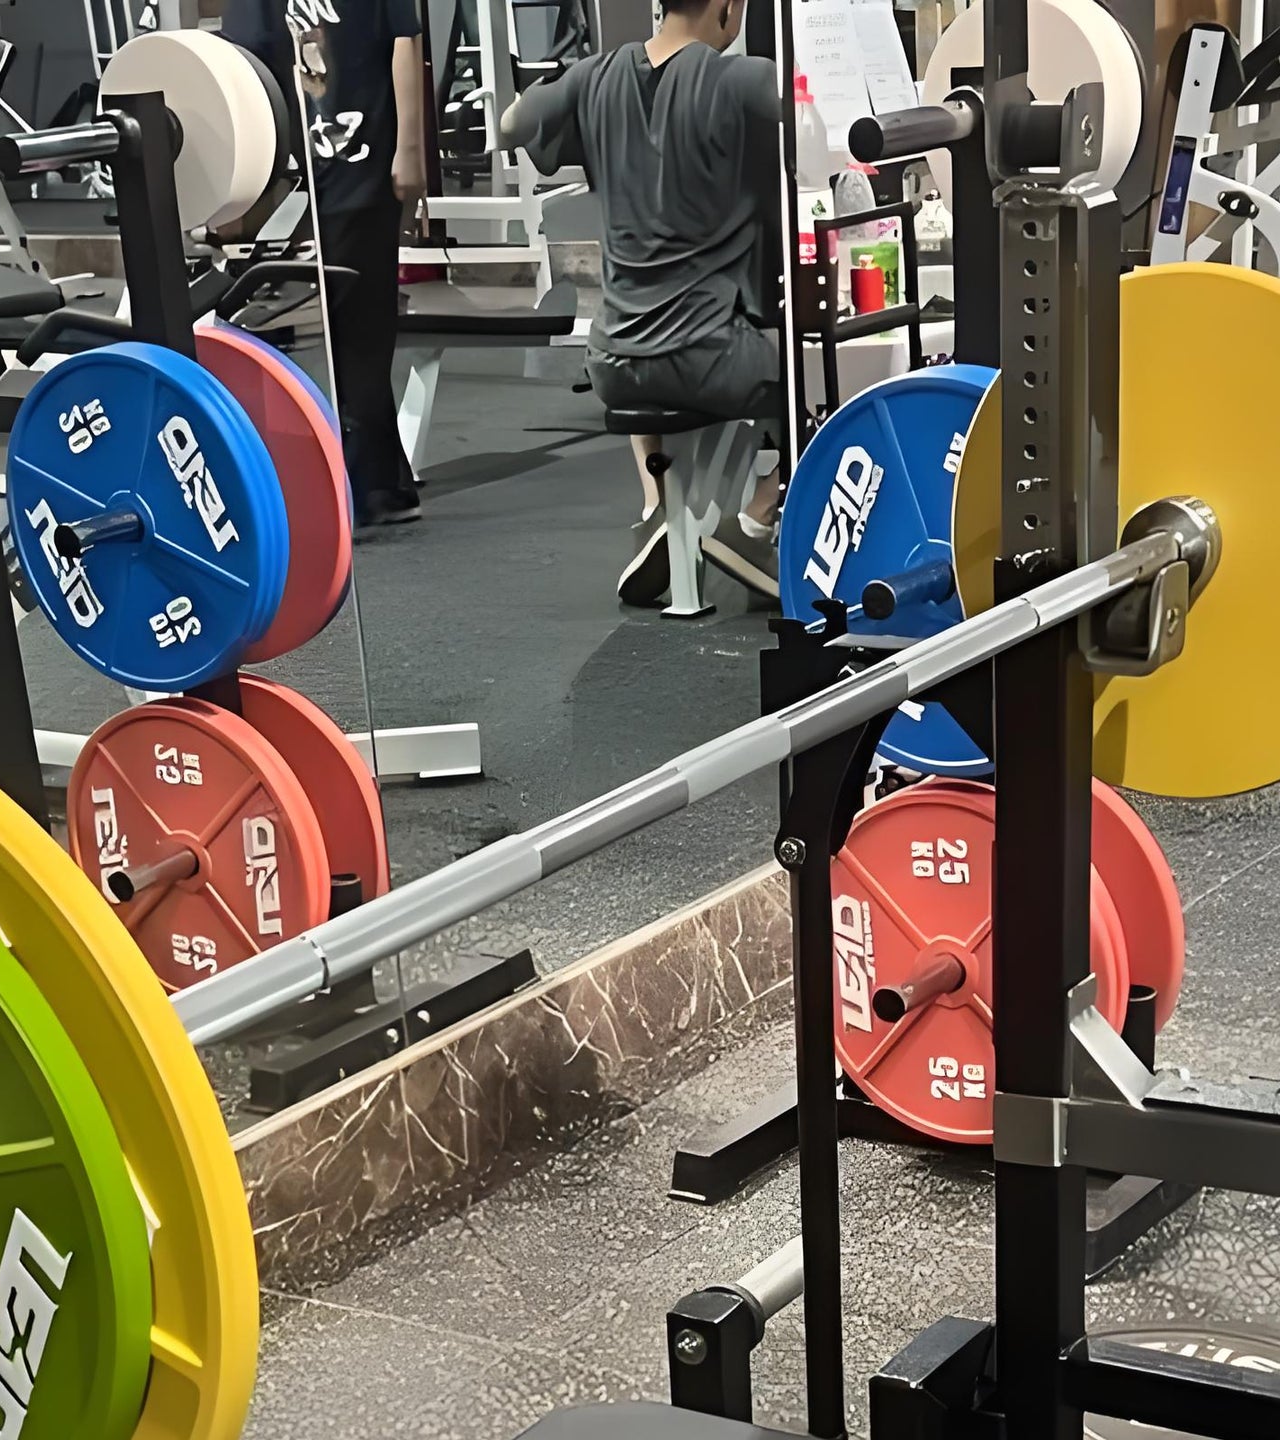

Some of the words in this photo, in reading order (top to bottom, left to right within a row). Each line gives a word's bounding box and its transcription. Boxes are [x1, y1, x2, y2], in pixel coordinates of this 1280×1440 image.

[803, 445, 875, 600] LEAD
[910, 840, 936, 879] KG
[936, 837, 970, 886] 25
[832, 893, 874, 1034] LEAD
[928, 1055, 961, 1102] 25
[961, 1063, 987, 1100] KG
